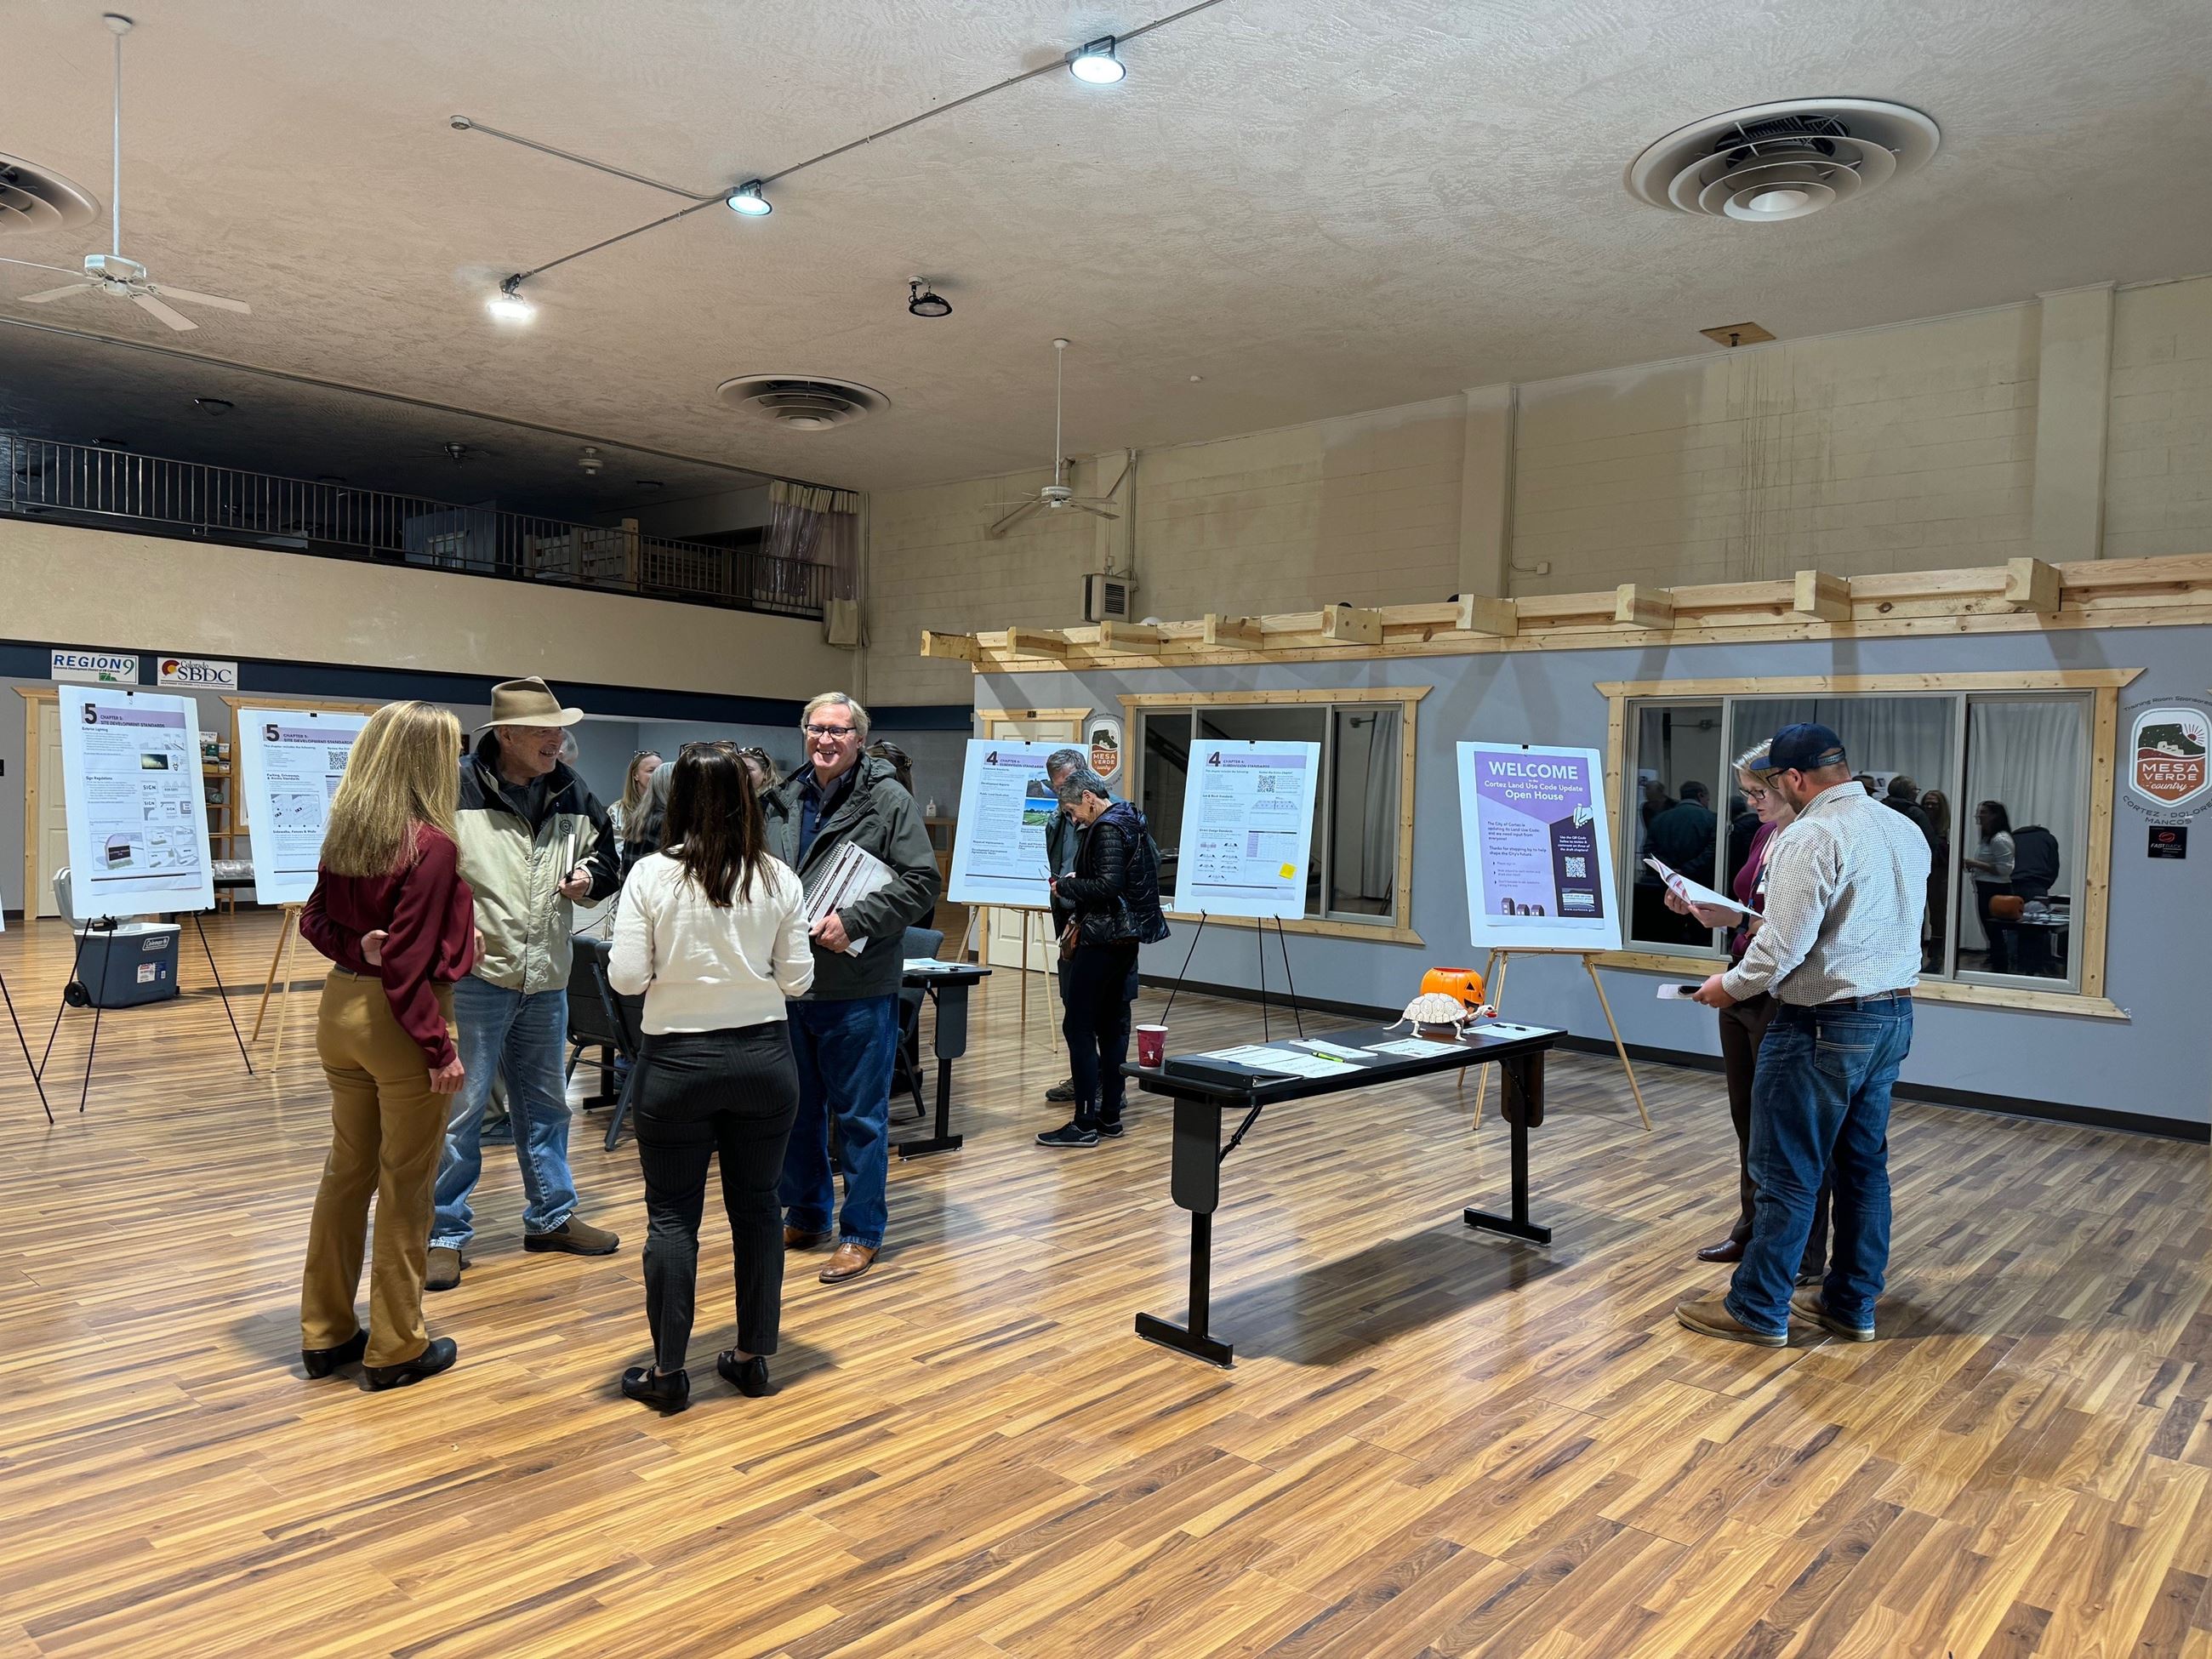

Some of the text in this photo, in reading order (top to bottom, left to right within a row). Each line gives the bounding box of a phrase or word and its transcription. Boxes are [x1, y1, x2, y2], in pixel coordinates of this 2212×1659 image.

[180, 660, 208, 669] Colorado
[177, 667, 231, 682] SBDC
[2124, 699, 2151, 711] Training
[84, 703, 97, 725] 5
[266, 724, 280, 742] 5
[986, 751, 998, 766] 4
[1209, 751, 1221, 767] 4
[1489, 761, 1578, 779] WELCOME
[2143, 763, 2199, 772] MESA
[2151, 782, 2187, 791] country
[1505, 790, 1564, 801] Open House
[2124, 795, 2159, 817] CORTEZ
[2145, 817, 2192, 825] MANCOS
